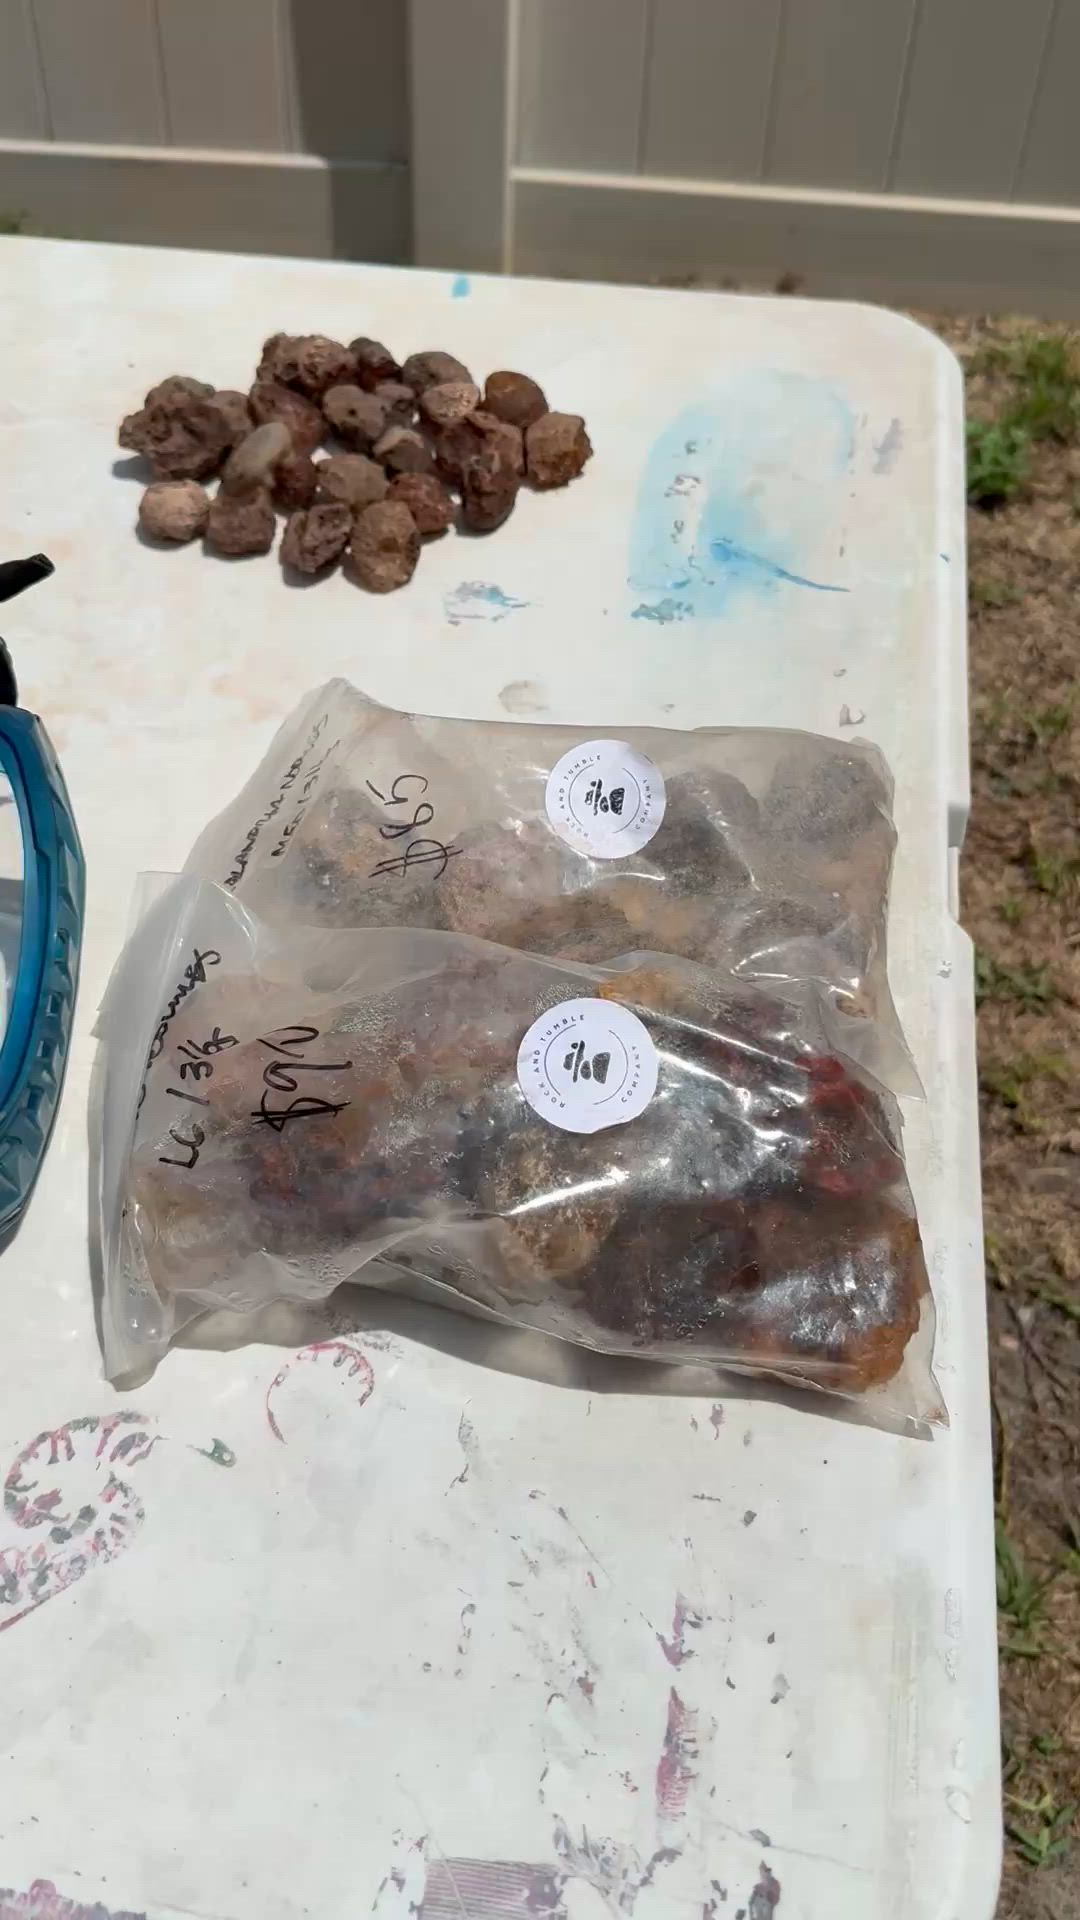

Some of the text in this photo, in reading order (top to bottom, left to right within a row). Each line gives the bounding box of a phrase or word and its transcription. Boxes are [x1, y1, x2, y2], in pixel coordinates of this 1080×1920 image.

[563, 754, 602, 781] TUMBLE
[367, 774, 465, 880] $85
[565, 817, 590, 838] ROCK
[635, 779, 652, 831] COMPANY
[250, 1025, 353, 1132] $90
[532, 1014, 586, 1109] ROCK AND TUMBLE
[620, 1045, 641, 1104] COMPANY
